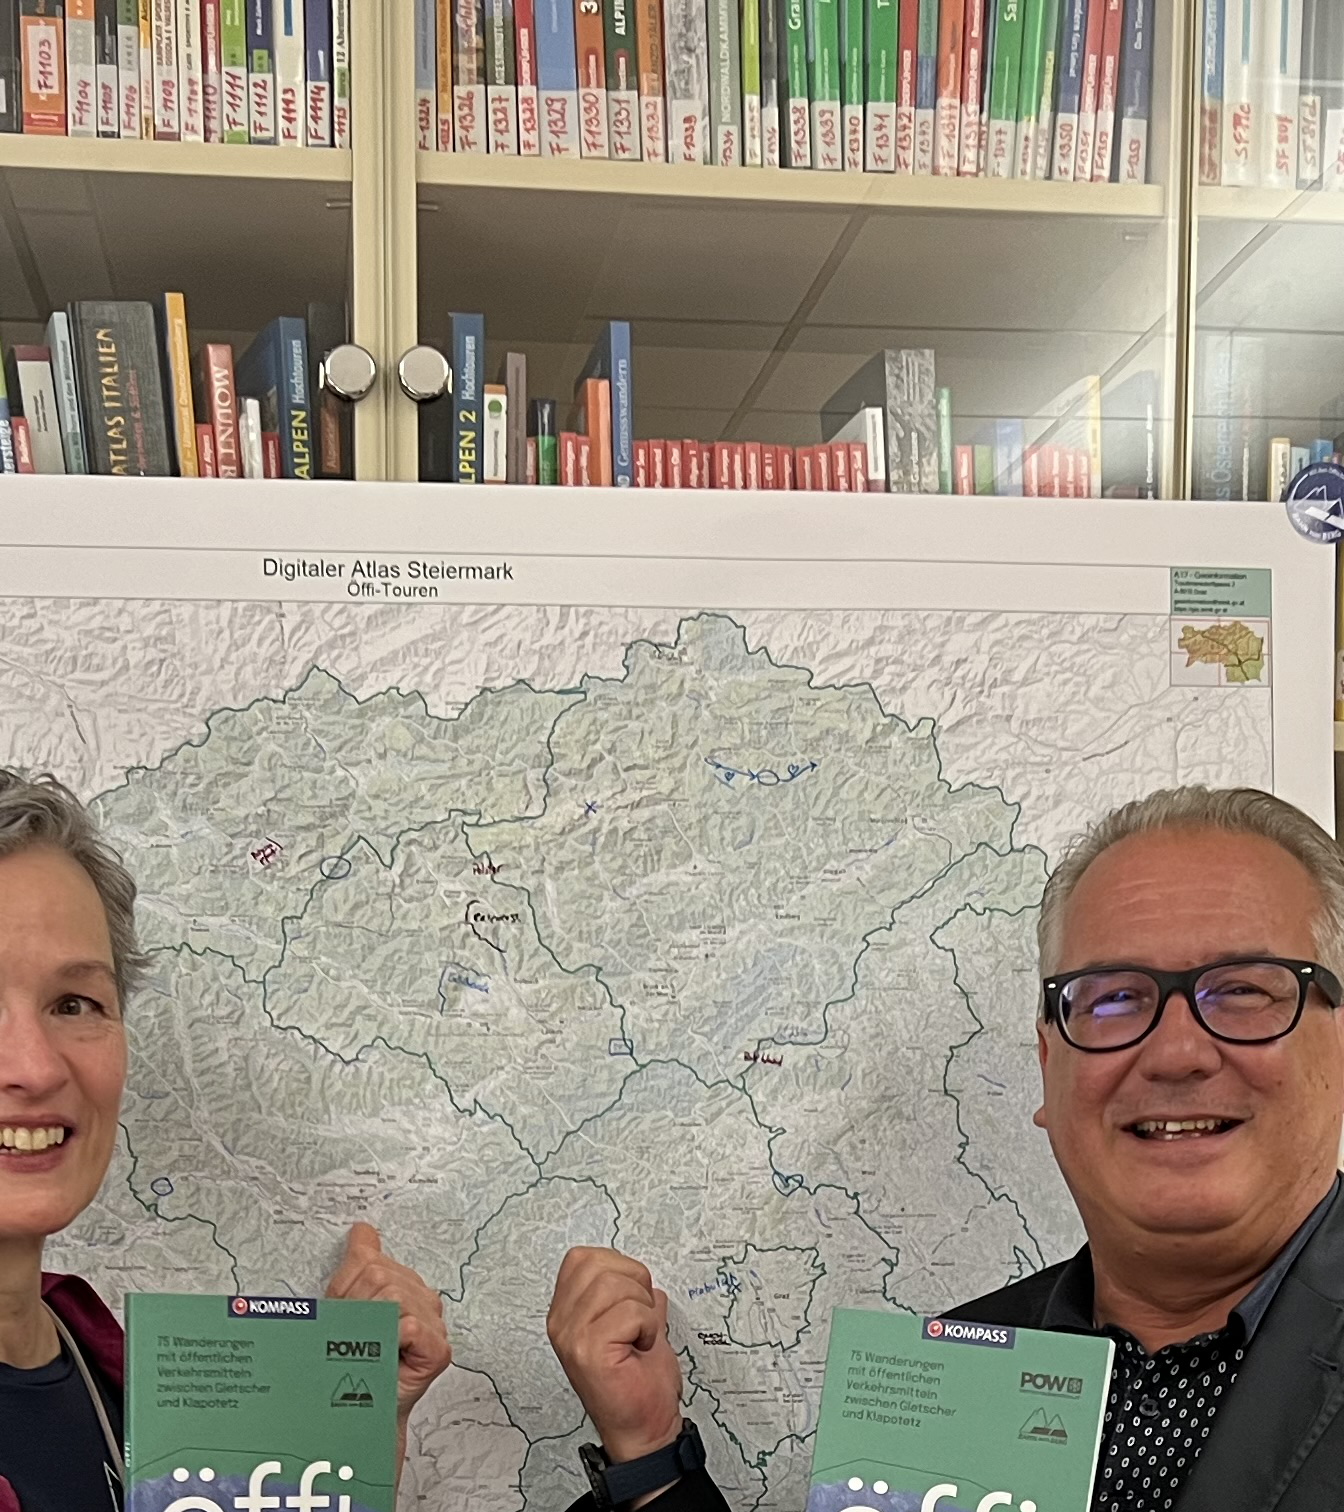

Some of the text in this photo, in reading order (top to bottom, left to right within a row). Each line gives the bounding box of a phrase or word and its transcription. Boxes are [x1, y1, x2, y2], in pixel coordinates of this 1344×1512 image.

[96, 327, 121, 407] ITALIEN
[291, 408, 311, 480] ALPEN
[263, 558, 514, 582] Digitaler Atlas Steiermark
[348, 580, 439, 597] Öffi-Touren
[249, 1300, 310, 1315] KOMPASS
[172, 1336, 255, 1350] Wanderungen
[944, 1324, 1008, 1344] KOMPASS
[326, 1340, 367, 1357] POW
[157, 1352, 253, 1364] mit öffentlichen
[864, 1351, 945, 1372] Wanderungen
[157, 1367, 252, 1378] Verkehrsmitteln
[847, 1366, 942, 1385] mit öffentlichen
[1020, 1371, 1068, 1392] POW
[157, 1382, 271, 1394] zwischen Gletscher
[846, 1379, 938, 1400] Verkehrsmitteln
[157, 1398, 239, 1409] und Klapotetz
[843, 1394, 957, 1418] zwischen Gletscher
[842, 1410, 921, 1428] und Klapotetz
